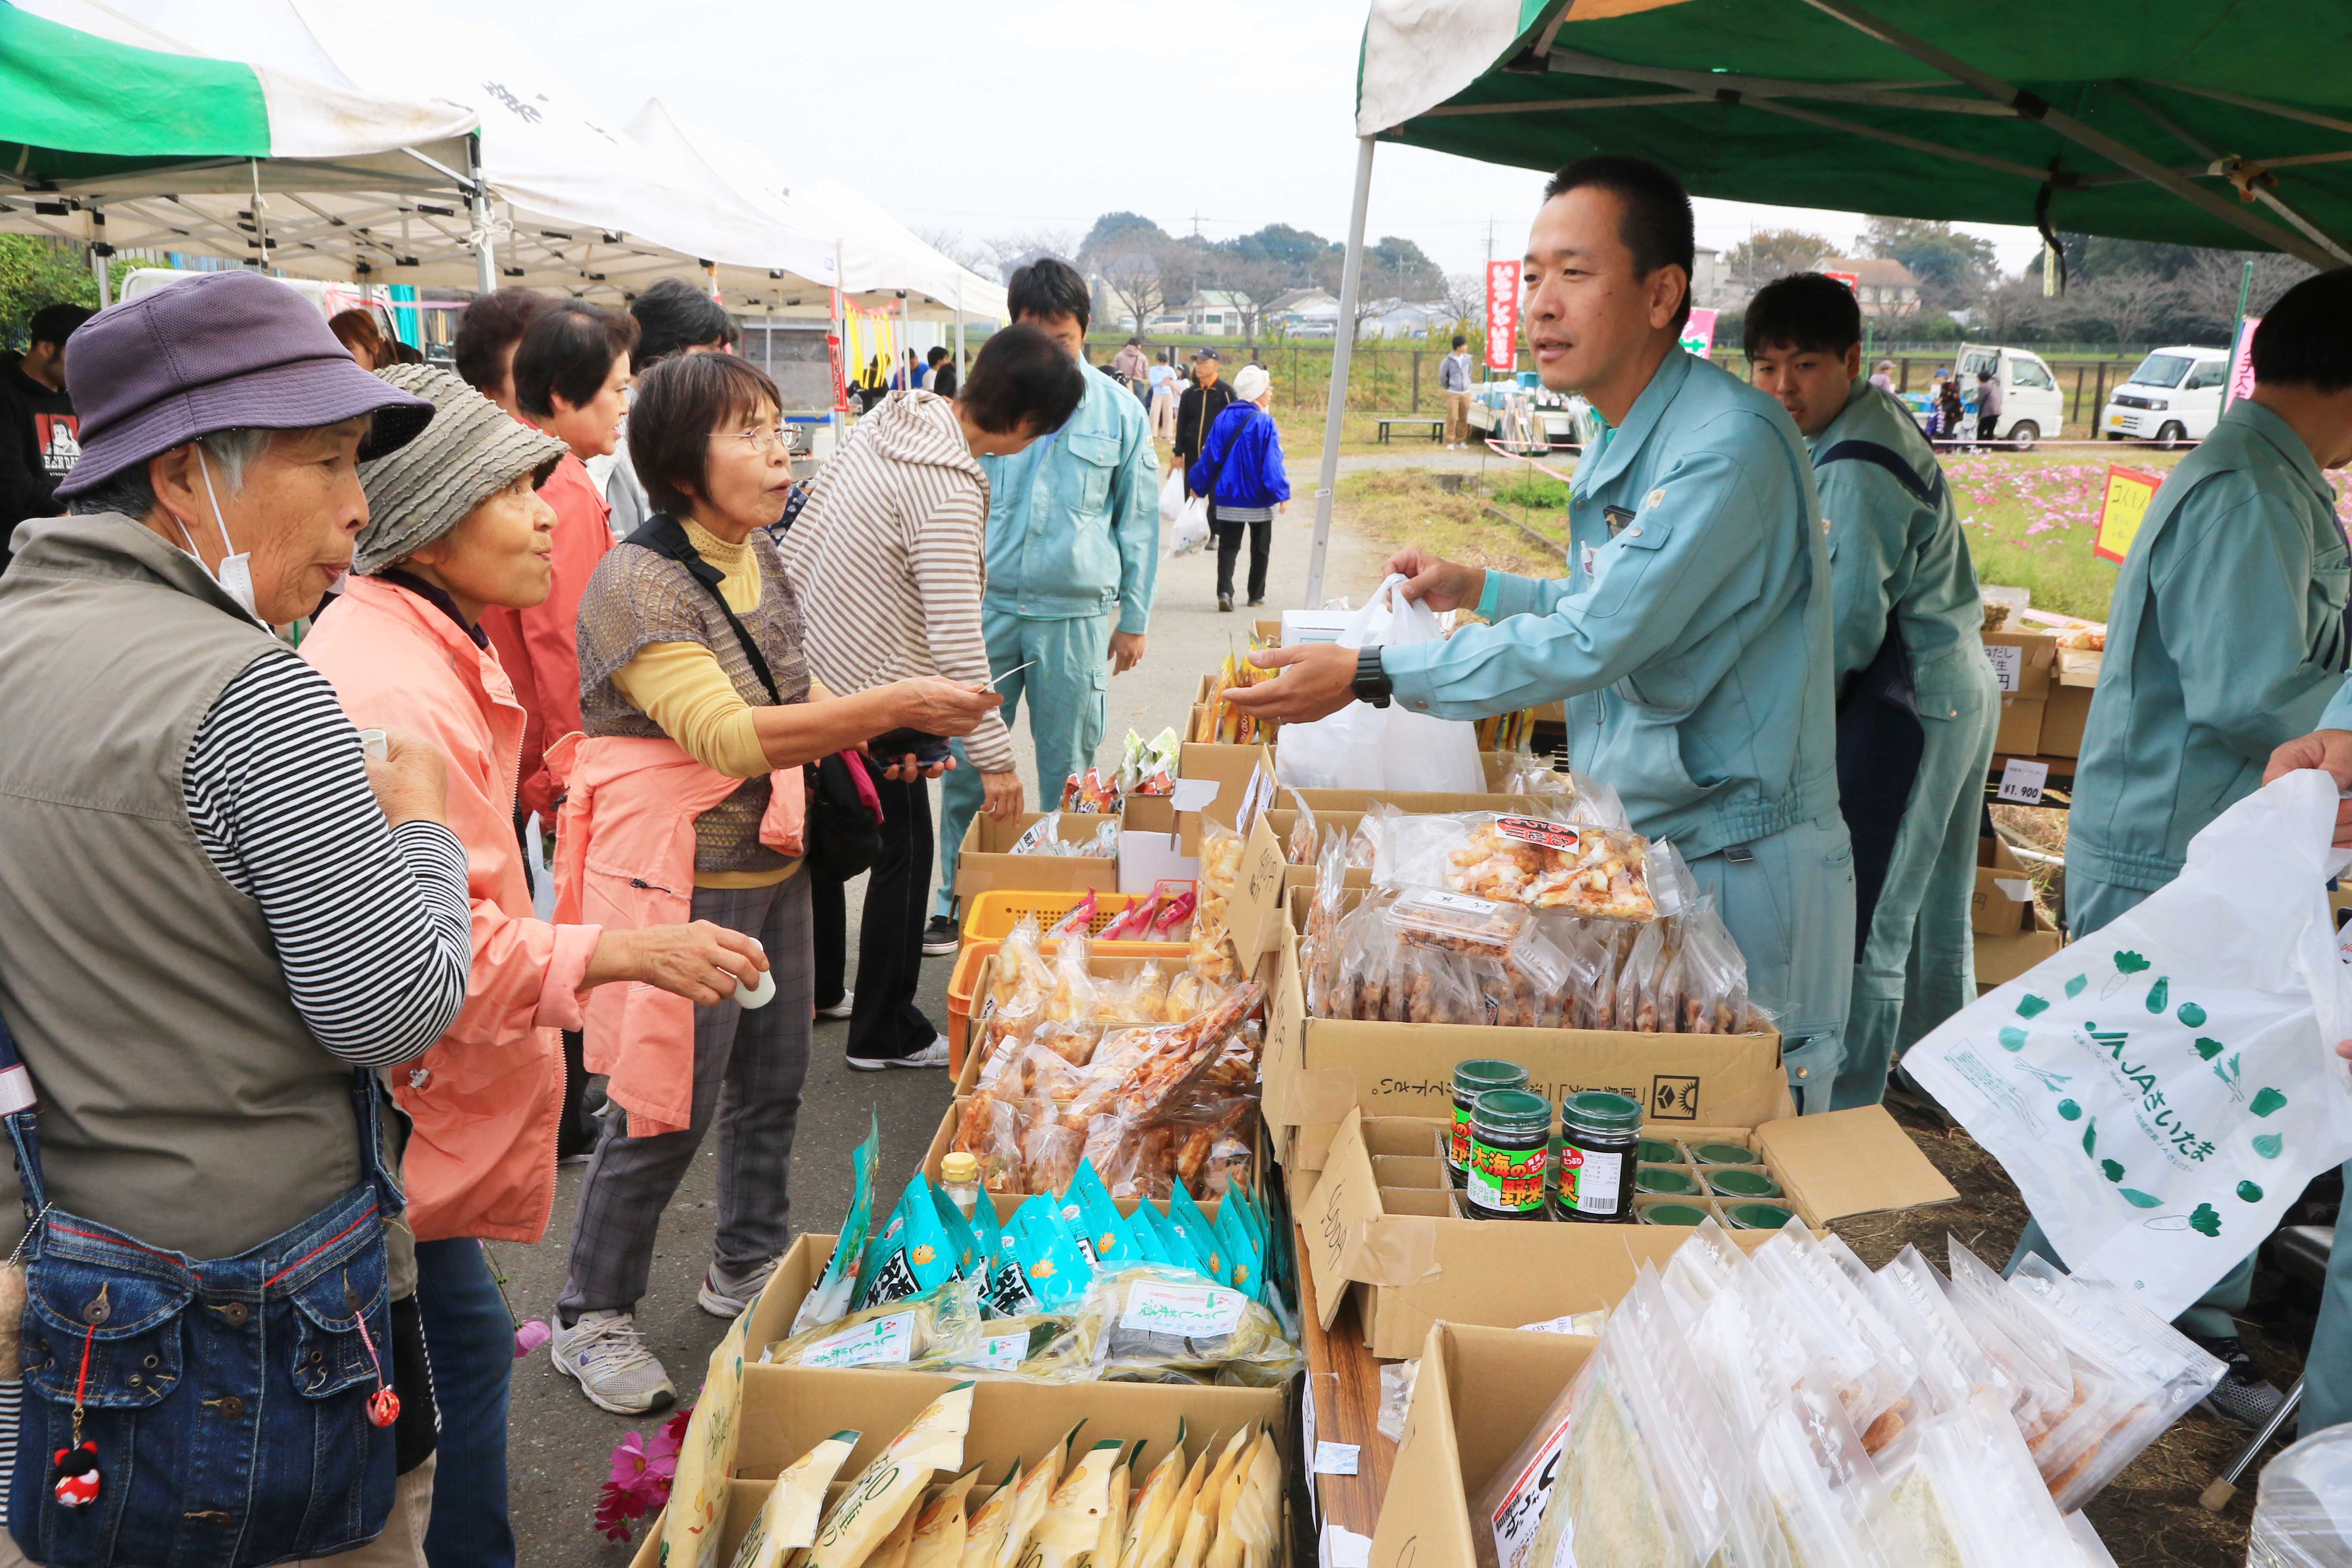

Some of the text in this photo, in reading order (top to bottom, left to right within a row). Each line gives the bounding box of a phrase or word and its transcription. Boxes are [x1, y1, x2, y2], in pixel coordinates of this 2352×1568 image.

[2121, 1061, 2216, 1162] JAさいたま
[1472, 1145, 1527, 1179] 大海の
[1564, 1157, 1582, 1165] たっぷり
[1500, 1173, 1544, 1206] 野菜
